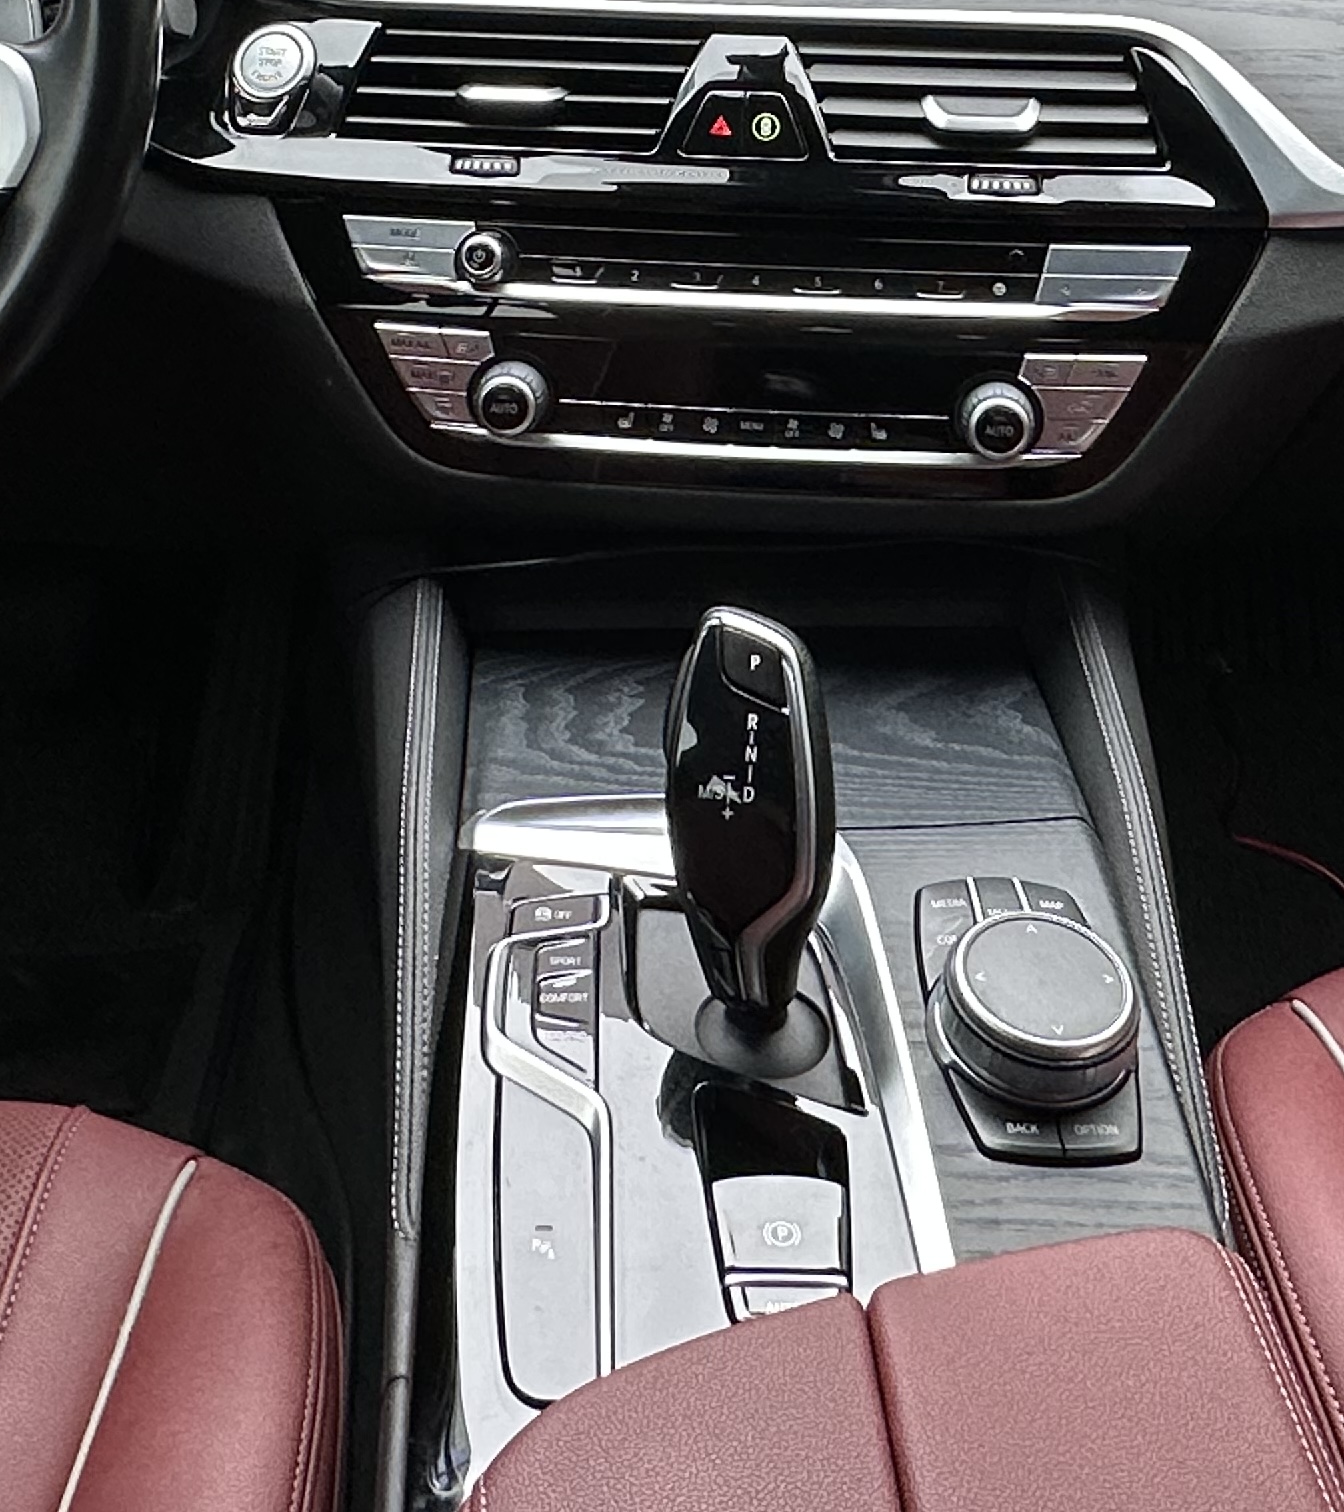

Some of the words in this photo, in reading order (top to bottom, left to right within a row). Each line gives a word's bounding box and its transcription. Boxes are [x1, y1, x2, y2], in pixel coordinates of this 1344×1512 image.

[630, 268, 640, 282] 2
[873, 278, 883, 290] 6
[490, 402, 519, 414] AUTO
[984, 424, 1015, 438] AUTO
[750, 654, 762, 671] P
[747, 713, 759, 730] R
[744, 744, 758, 762] N
[742, 786, 756, 803] D
[1038, 899, 1065, 910] MAP
[553, 909, 573, 920] OFF
[548, 956, 582, 966] SPORT
[538, 992, 589, 1004] COMFORT
[1005, 1121, 1040, 1135] BACK
[1073, 1123, 1120, 1136] OPTION
